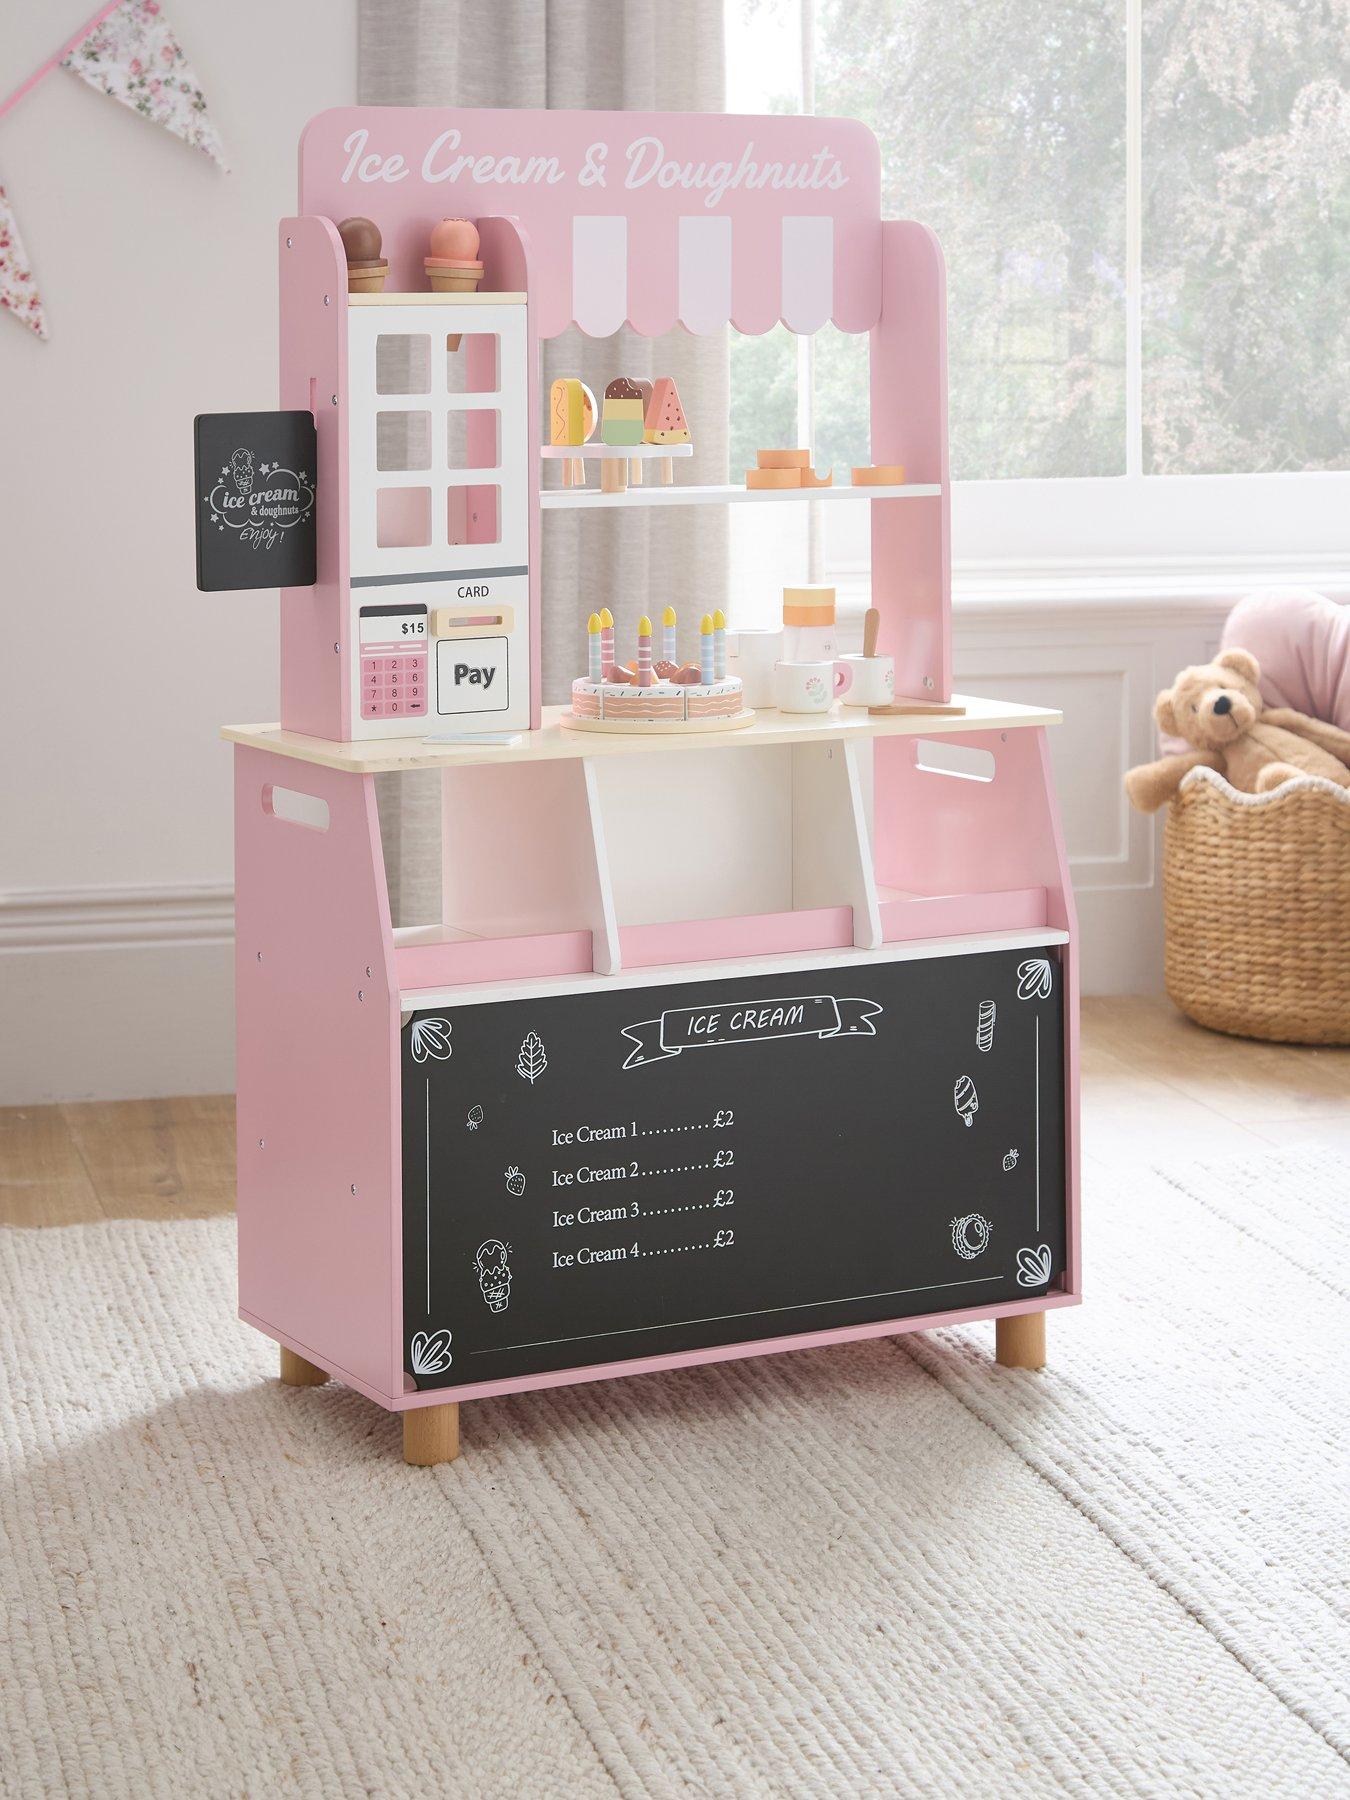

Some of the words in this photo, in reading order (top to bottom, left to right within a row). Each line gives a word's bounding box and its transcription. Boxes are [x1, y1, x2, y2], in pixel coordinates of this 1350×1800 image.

[341, 128, 409, 183] Ice
[421, 128, 565, 185] Cream
[577, 142, 608, 188] &
[625, 136, 849, 208] Doughnuts
[223, 492, 246, 508] ice
[249, 488, 299, 505] cream
[251, 507, 258, 515] &
[259, 505, 299, 518] doughnuts
[457, 586, 489, 598] CARD
[401, 622, 424, 634] $15
[454, 663, 496, 689] Pay
[371, 690, 377, 698] 7
[392, 689, 397, 697] 8
[412, 688, 418, 696] 9
[392, 703, 397, 711] 0
[688, 1015, 720, 1035] ICE
[730, 1005, 804, 1030] CREAM
[552, 1128, 573, 1145] Ice
[577, 1125, 626, 1143] Cream
[552, 1170, 573, 1186] Ice
[577, 1165, 626, 1183] Cream
[553, 1210, 574, 1227] Ice
[577, 1206, 627, 1224] Cream
[553, 1251, 574, 1267] Ice
[577, 1246, 627, 1265] Cream
